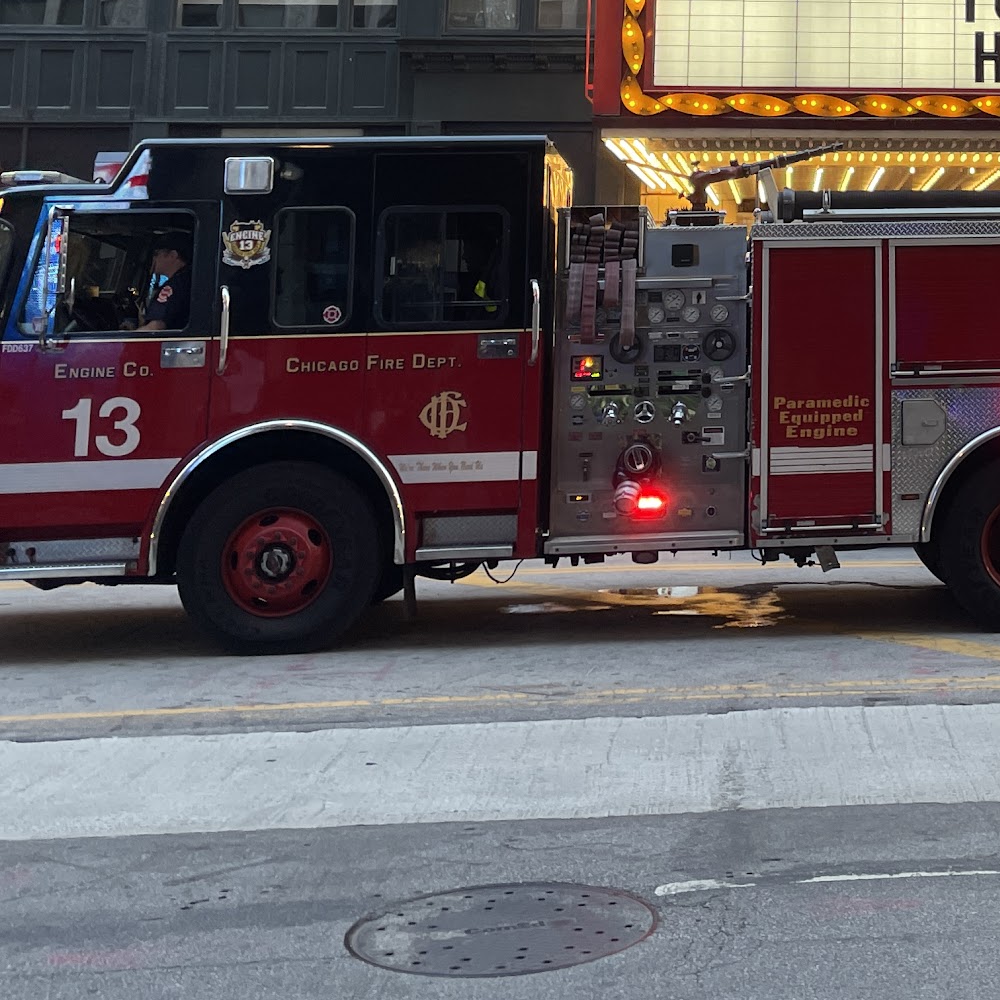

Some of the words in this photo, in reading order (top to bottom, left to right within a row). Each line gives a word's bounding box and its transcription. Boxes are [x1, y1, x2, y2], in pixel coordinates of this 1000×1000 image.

[230, 230, 264, 241] ENGINE
[239, 240, 254, 250] 13
[2, 344, 34, 353] FDD637
[773, 394, 870, 409] Paramedic
[779, 409, 864, 425] Equipped
[61, 396, 141, 457] 13
[785, 424, 858, 439] Engine
